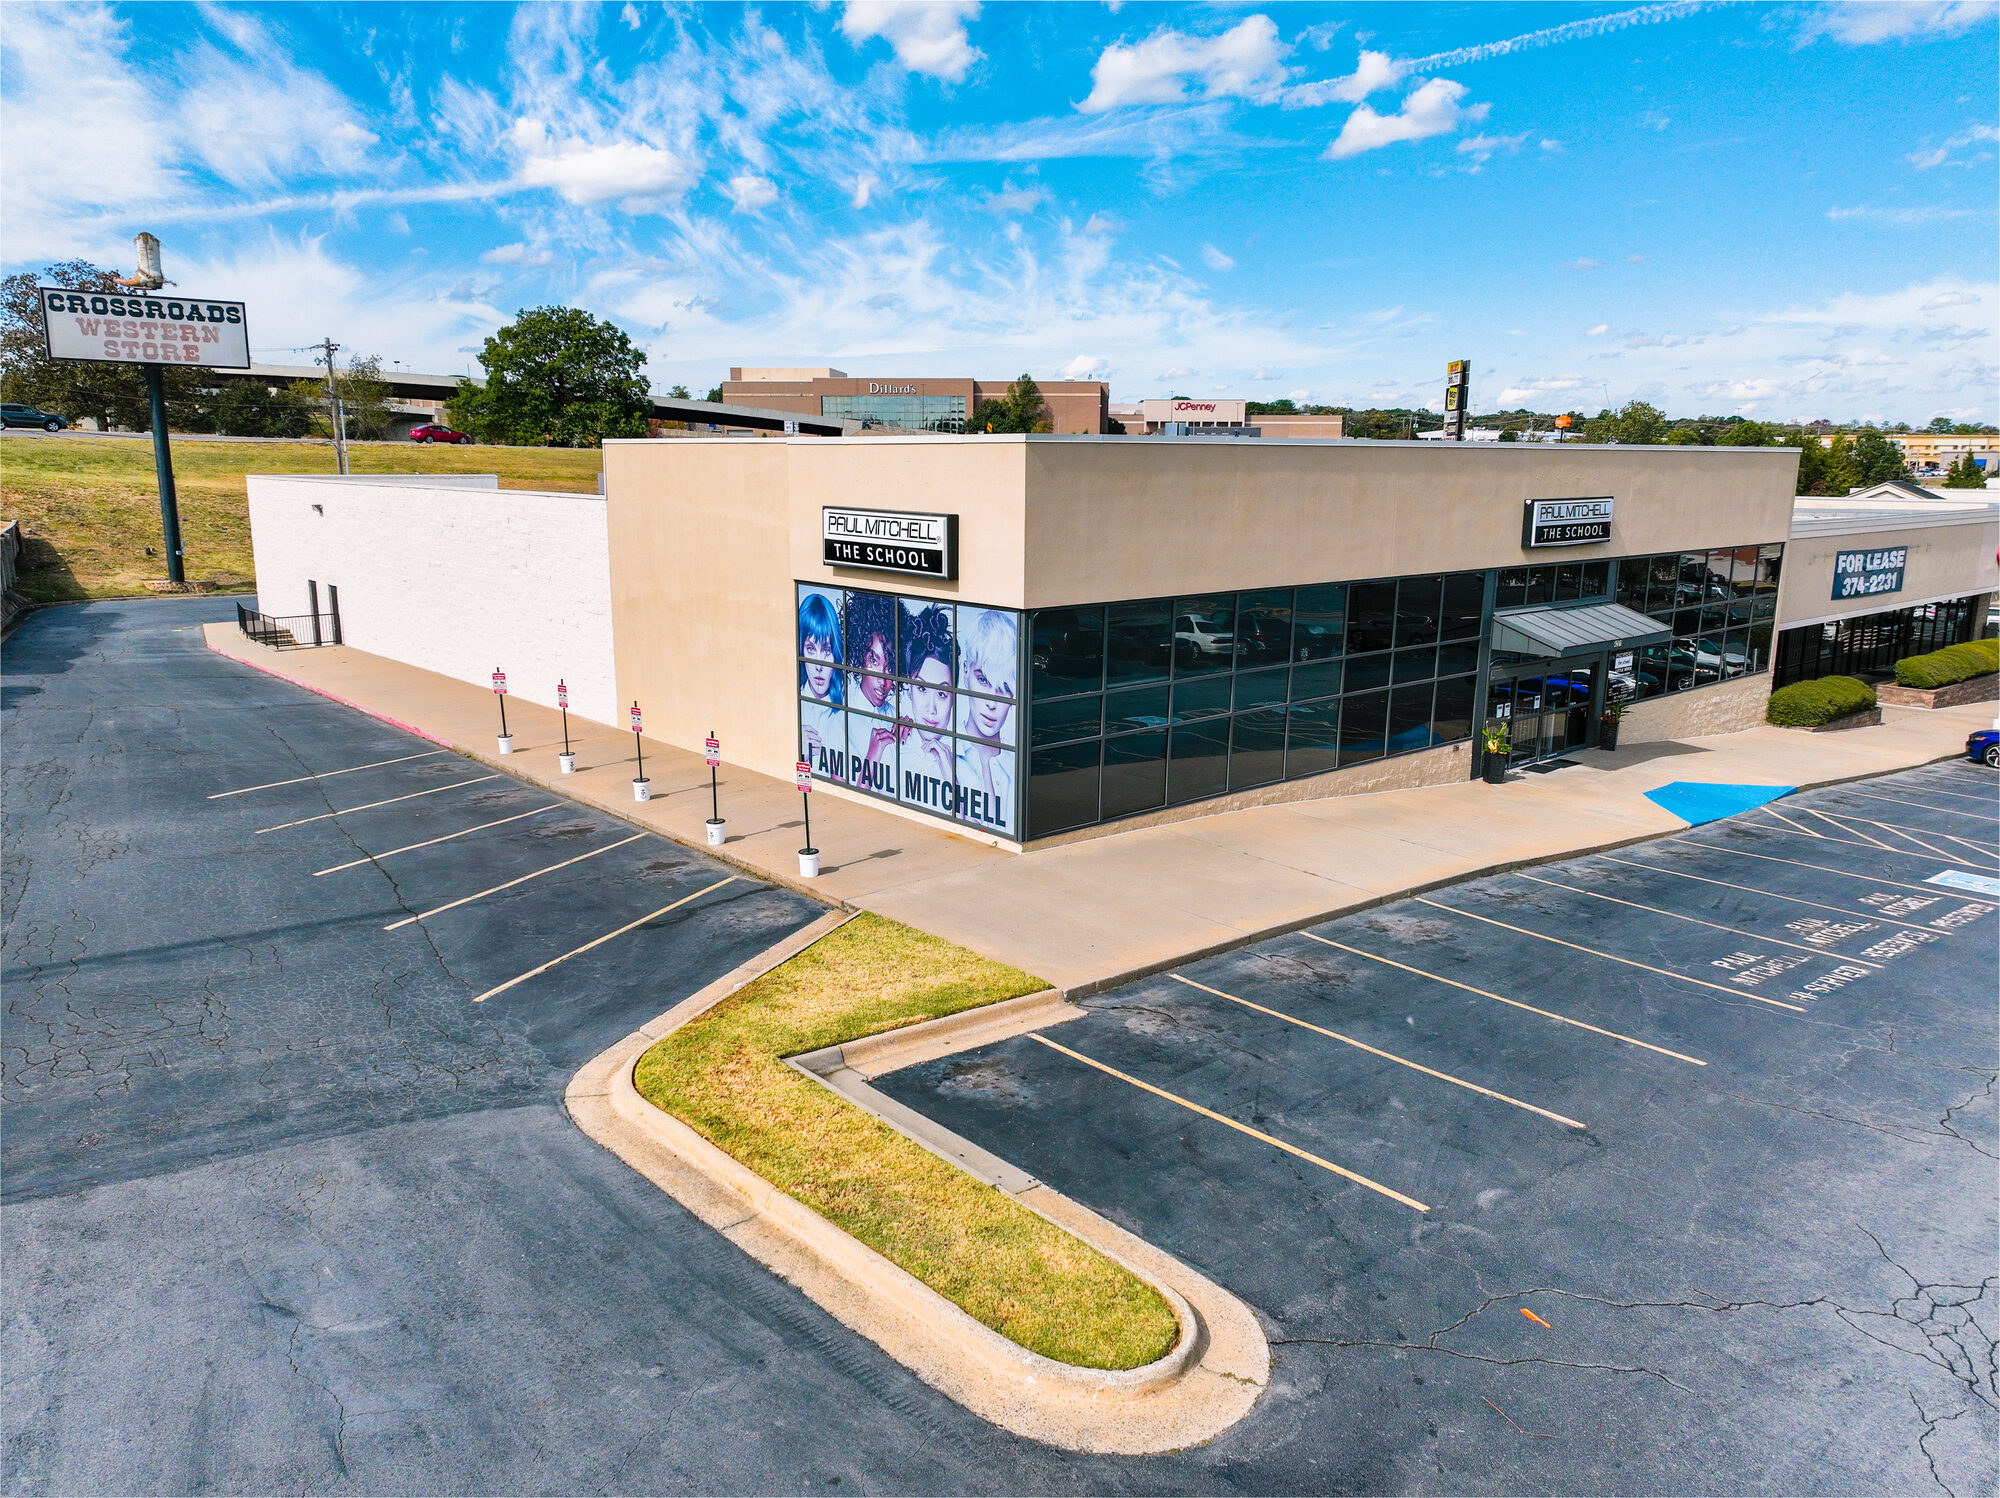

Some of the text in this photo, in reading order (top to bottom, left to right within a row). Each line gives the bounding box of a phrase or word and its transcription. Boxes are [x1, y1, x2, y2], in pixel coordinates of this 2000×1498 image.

[47, 293, 242, 324] CROSSROADS
[75, 317, 220, 344] WESTERN
[103, 340, 201, 363] STORE
[869, 382, 917, 394] Dillard's
[1175, 402, 1216, 412] JCPenney
[1540, 504, 1610, 519] PAUL MITCHELL
[828, 515, 937, 541] PAUL MITCHELL
[1543, 524, 1603, 540] THE SCHOOL
[833, 543, 929, 567] THE SCHOOL
[1837, 550, 1906, 574] FOR LEASE
[1841, 572, 1898, 596] 374-2231
[808, 742, 813, 768] I
[818, 746, 844, 778] AM
[852, 755, 895, 794] PAUL
[905, 770, 1006, 828] MITCHELL
[1711, 951, 1766, 970] PAUL
